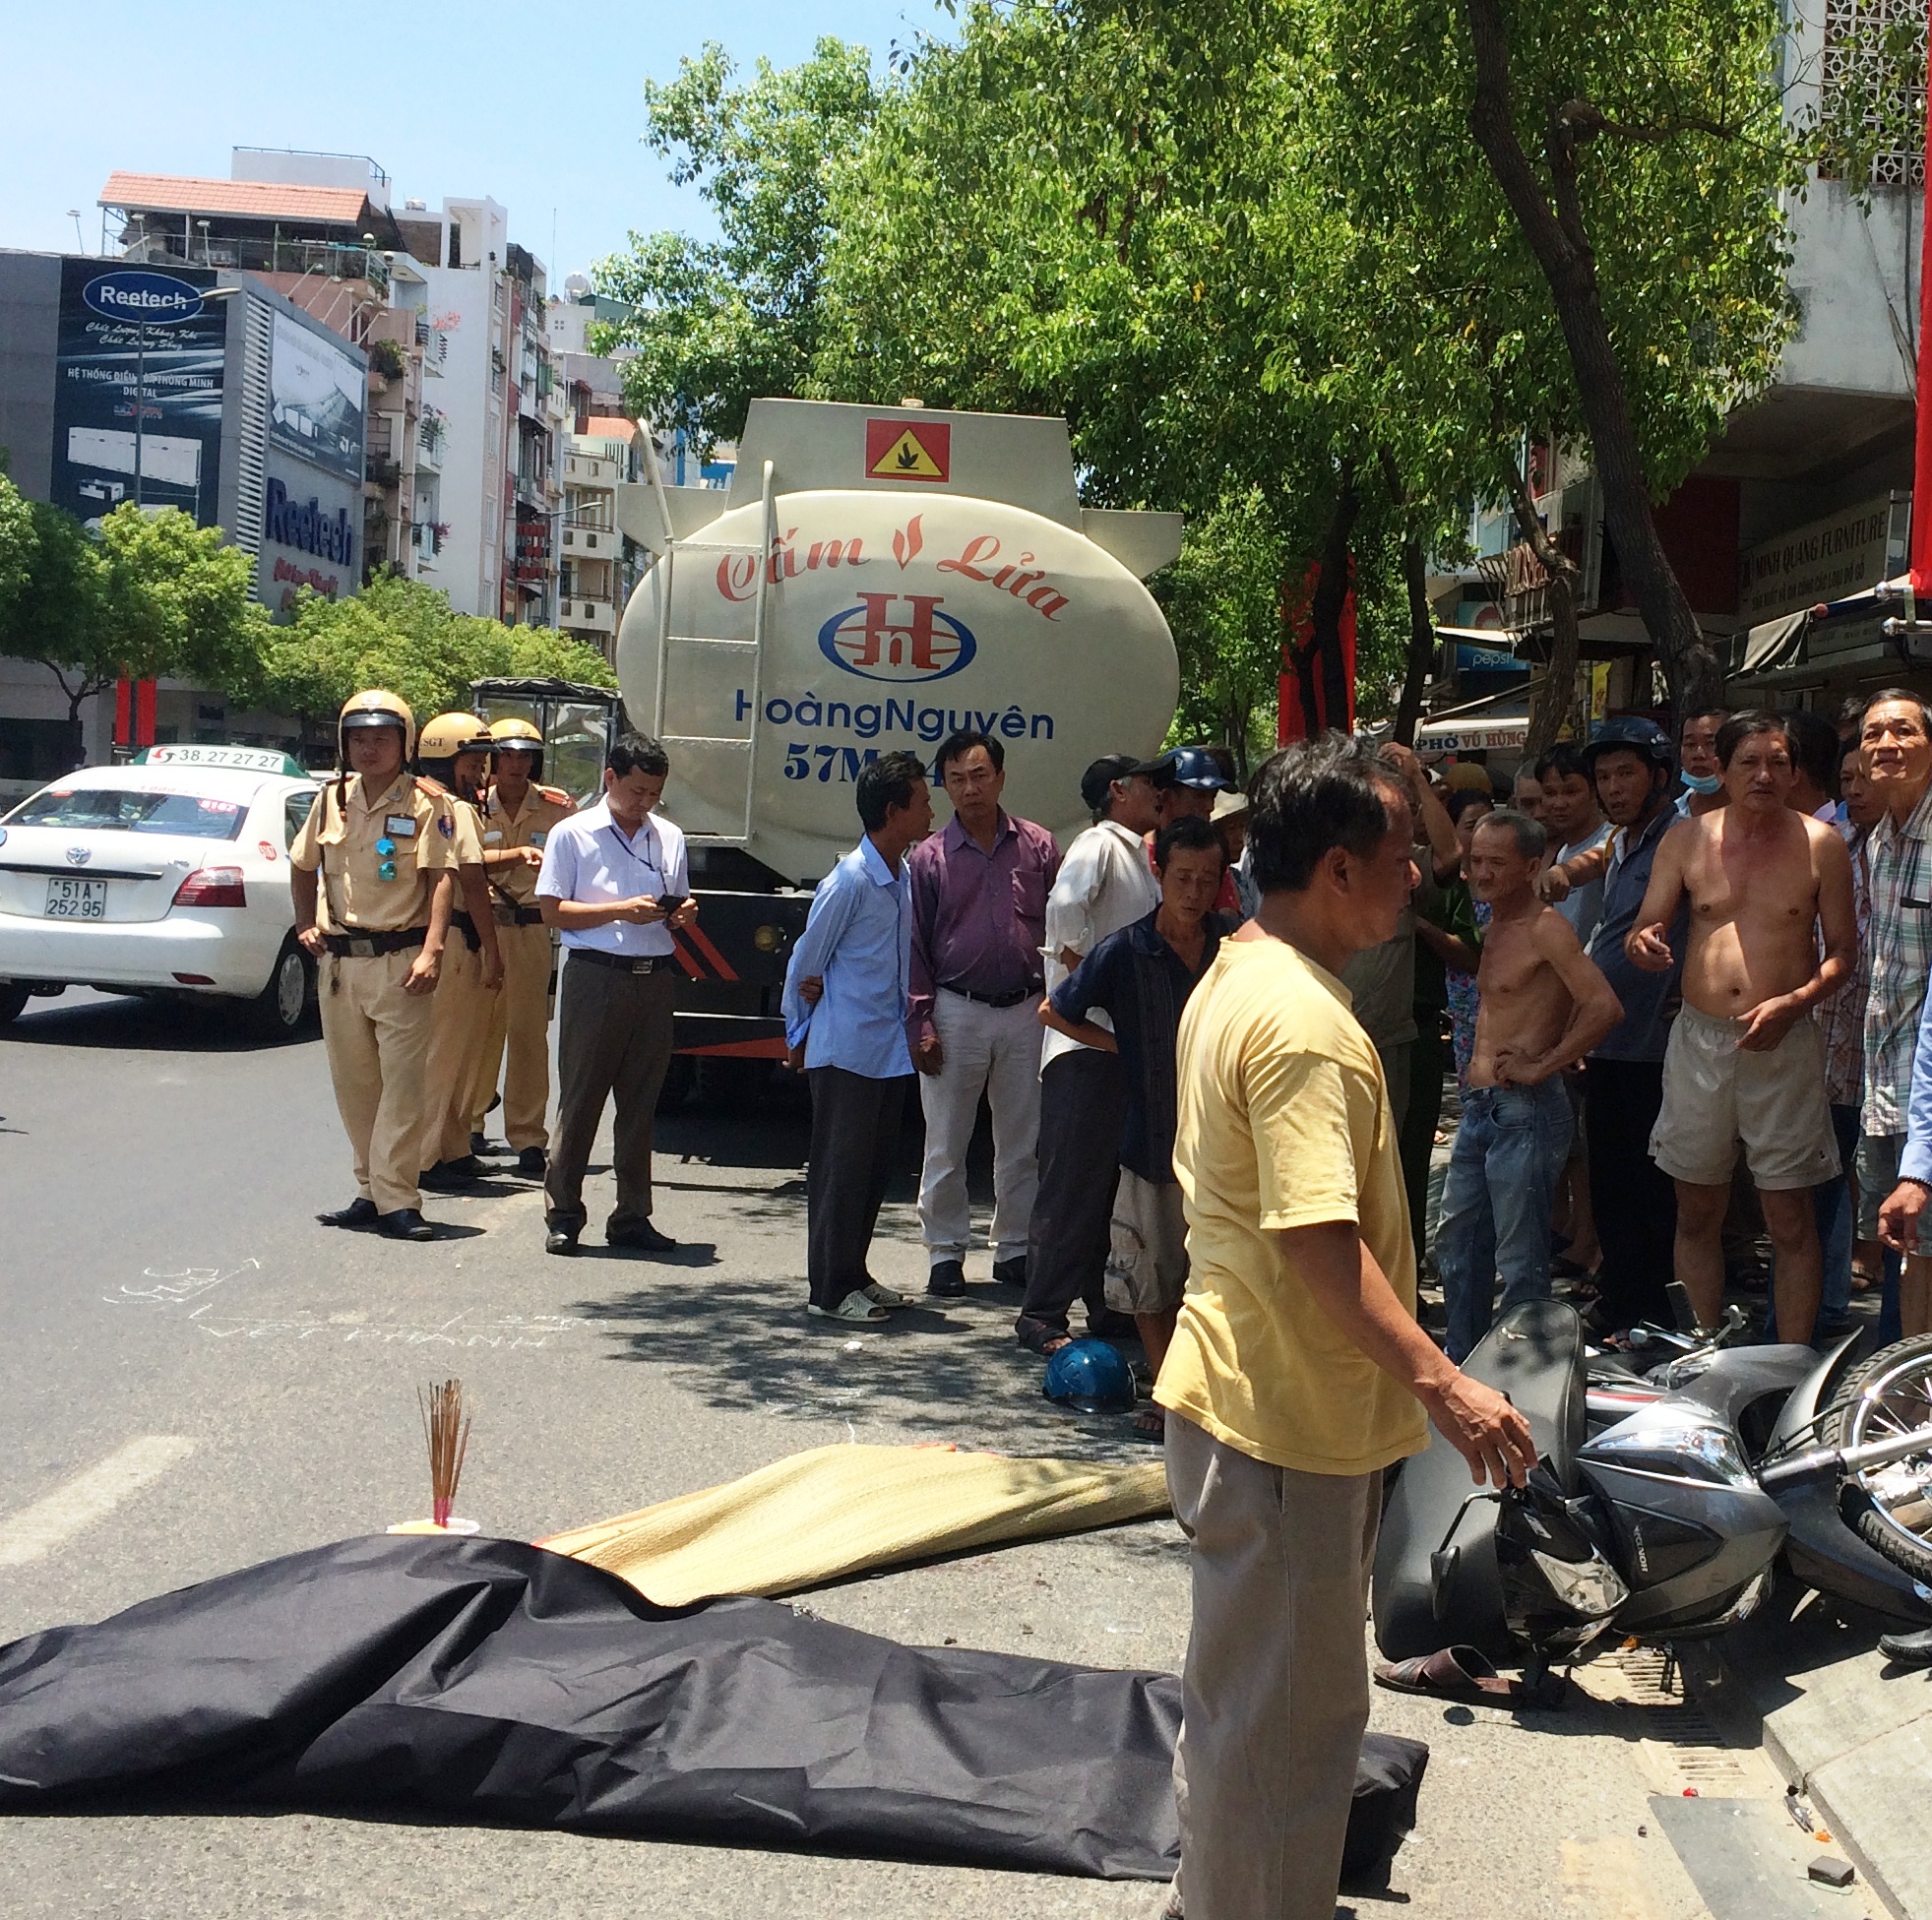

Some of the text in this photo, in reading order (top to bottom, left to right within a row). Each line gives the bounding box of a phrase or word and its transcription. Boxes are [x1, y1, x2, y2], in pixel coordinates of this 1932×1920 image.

[100, 285, 187, 310] Reetech
[123, 387, 157, 398] DIGTAL
[189, 378, 214, 389] MINH
[265, 477, 352, 566] Reetech
[1782, 535, 1818, 574] QUANG
[1821, 511, 1886, 559] FURNITURE
[717, 527, 1070, 621] Cấm Lửa
[179, 749, 280, 768] 38.27 27 27
[62, 882, 92, 899] 51A
